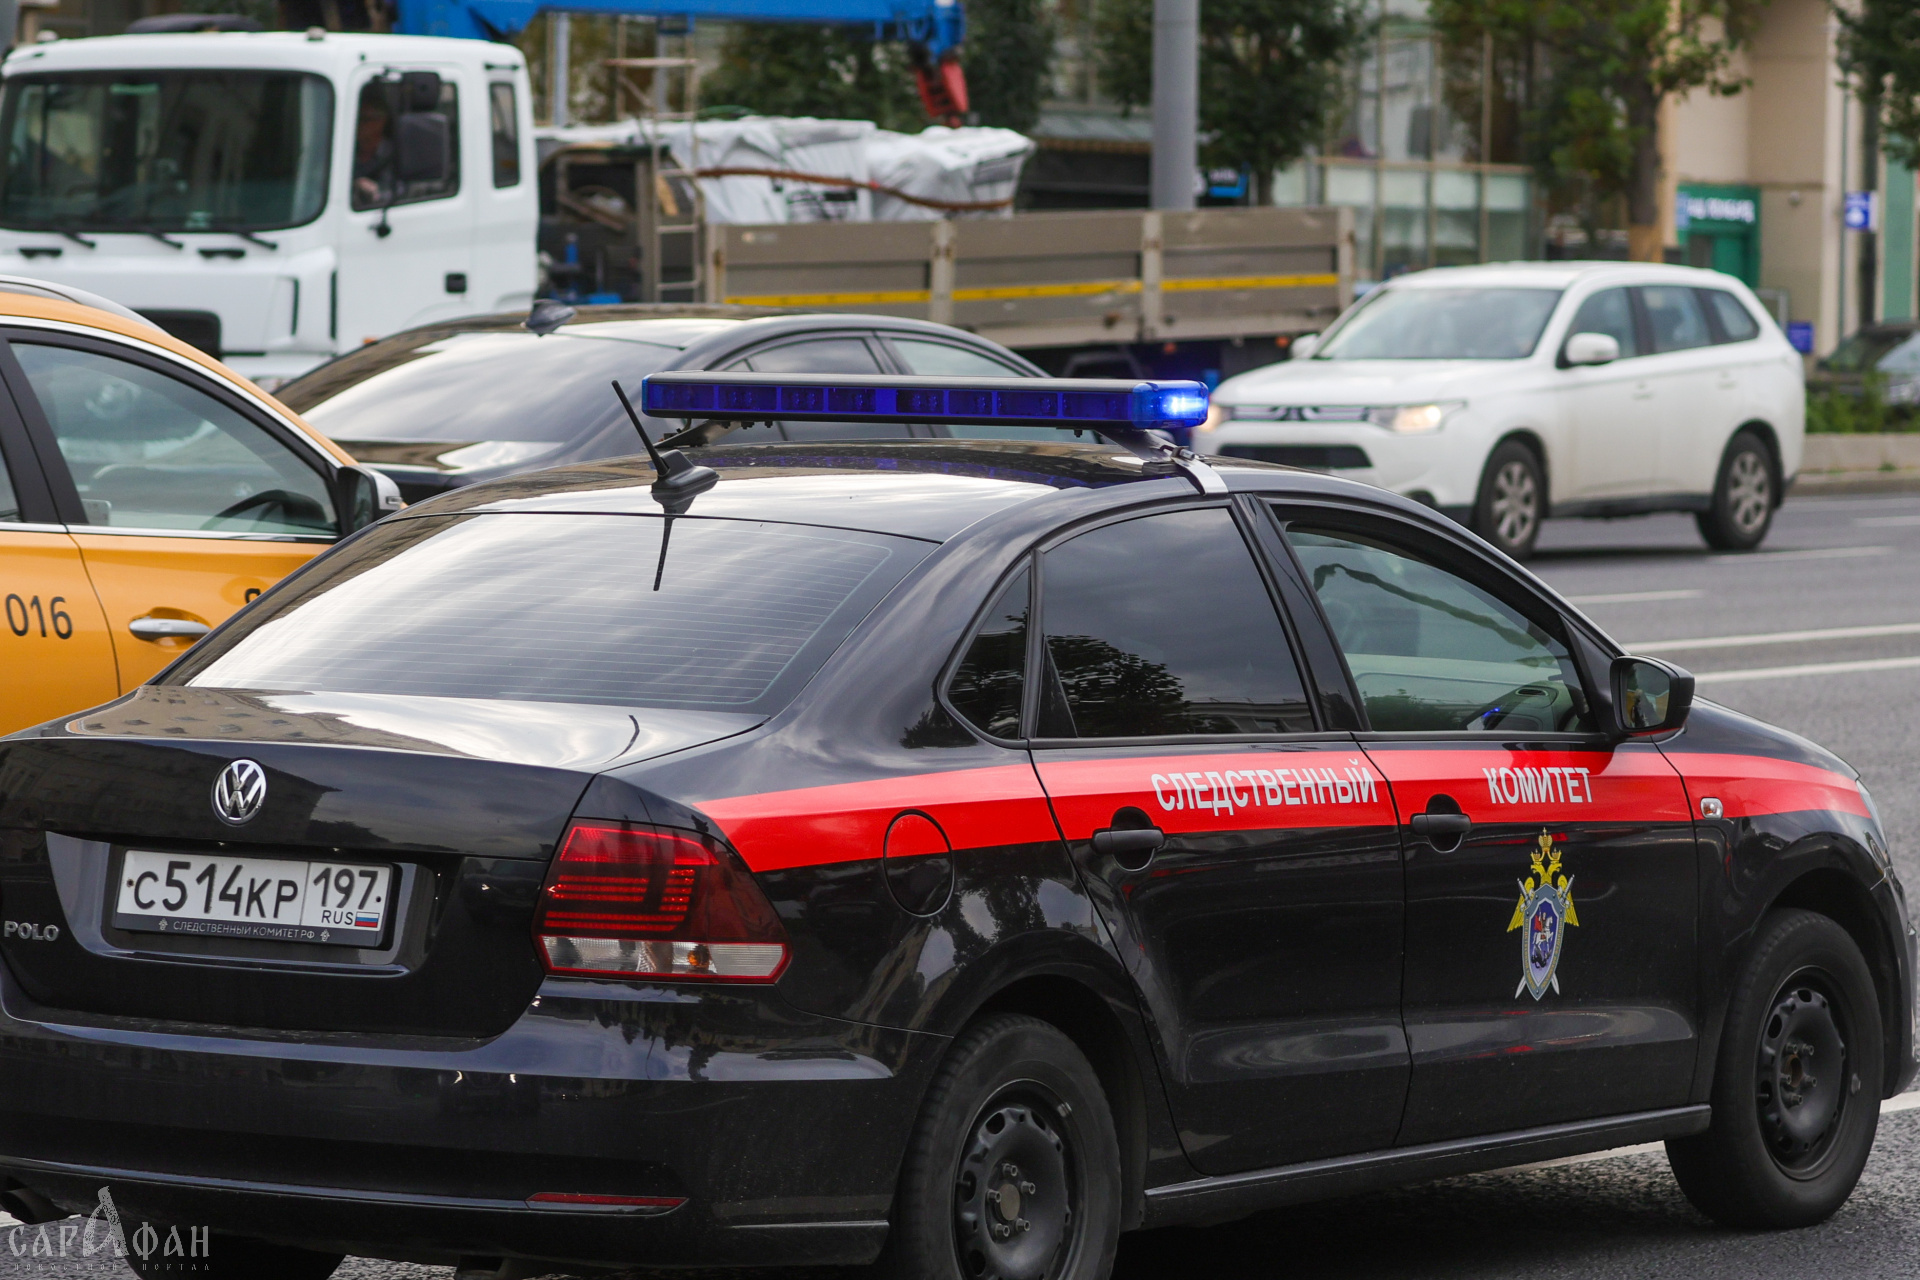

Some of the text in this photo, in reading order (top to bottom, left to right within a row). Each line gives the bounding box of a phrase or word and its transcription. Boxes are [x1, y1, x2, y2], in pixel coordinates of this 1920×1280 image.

[5, 593, 73, 640] 016
[1151, 758, 1593, 817] СЛЕДСТВЕННЫЙ КОМИТЕТ
[312, 867, 379, 911] 197
[3, 920, 60, 942] POLO
[173, 920, 316, 940] СЛЕДСТВЕННЫЙ КОМИТЕТ РФ
[321, 909, 354, 926] RUS
